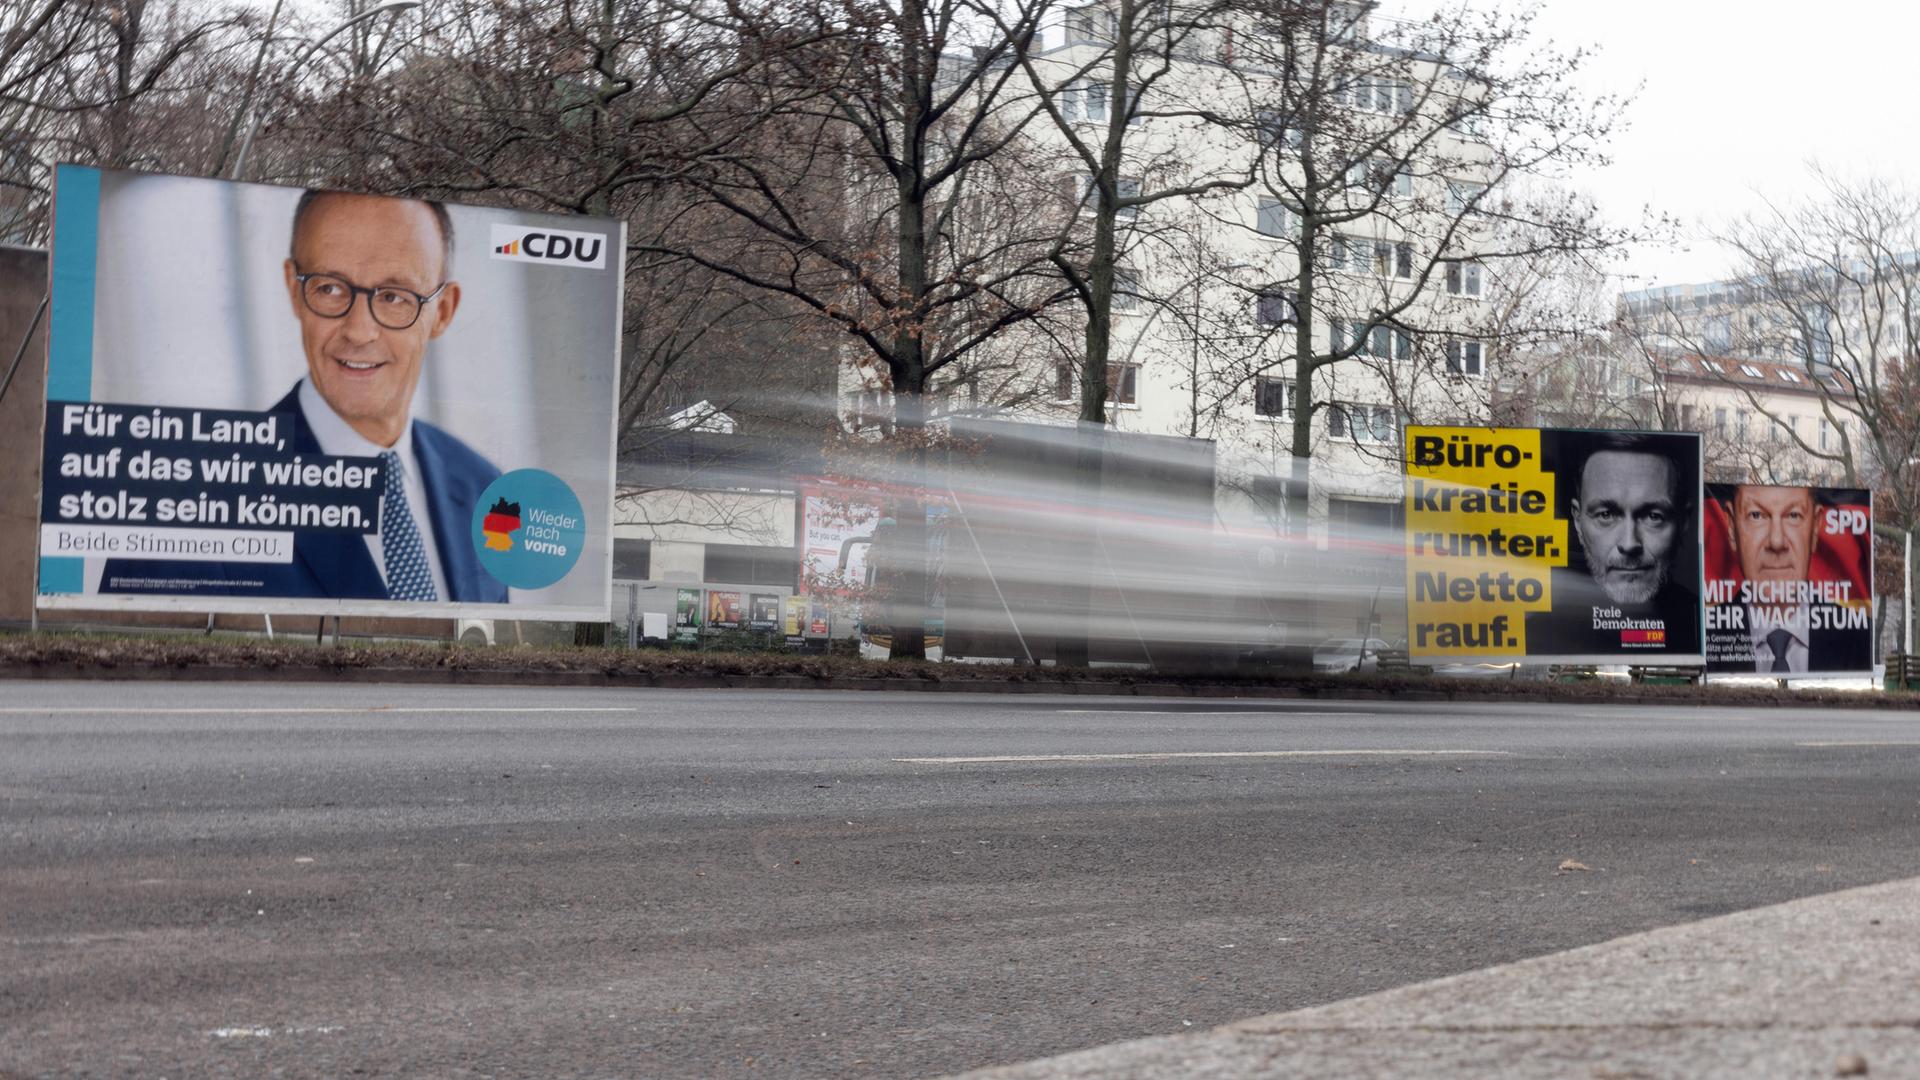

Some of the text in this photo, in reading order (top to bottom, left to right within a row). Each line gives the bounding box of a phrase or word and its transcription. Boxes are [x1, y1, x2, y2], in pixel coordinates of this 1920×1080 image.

[522, 233, 601, 262] CDU
[62, 405, 286, 451] Für ein Land,
[1414, 433, 1532, 468] Büro-
[60, 447, 378, 489] auf das wir wieder
[59, 490, 371, 528] stolz sein können.
[1414, 480, 1546, 514] kratie
[528, 508, 577, 529] Wieder
[1825, 509, 1867, 535] SPD
[57, 531, 282, 556] Beide Stimmen CDU.
[526, 525, 560, 541] nach
[1414, 528, 1560, 557] runter.
[524, 539, 567, 557] vorne
[1415, 571, 1543, 602] Netto
[1704, 579, 1852, 604] MIT SICHERHEIT
[1592, 606, 1621, 618] Freie
[1593, 617, 1665, 629] Demokraten
[1705, 605, 1868, 630] EHR WACHSTUM
[1416, 616, 1518, 648] rauf.
[1647, 631, 1664, 640] FDP
